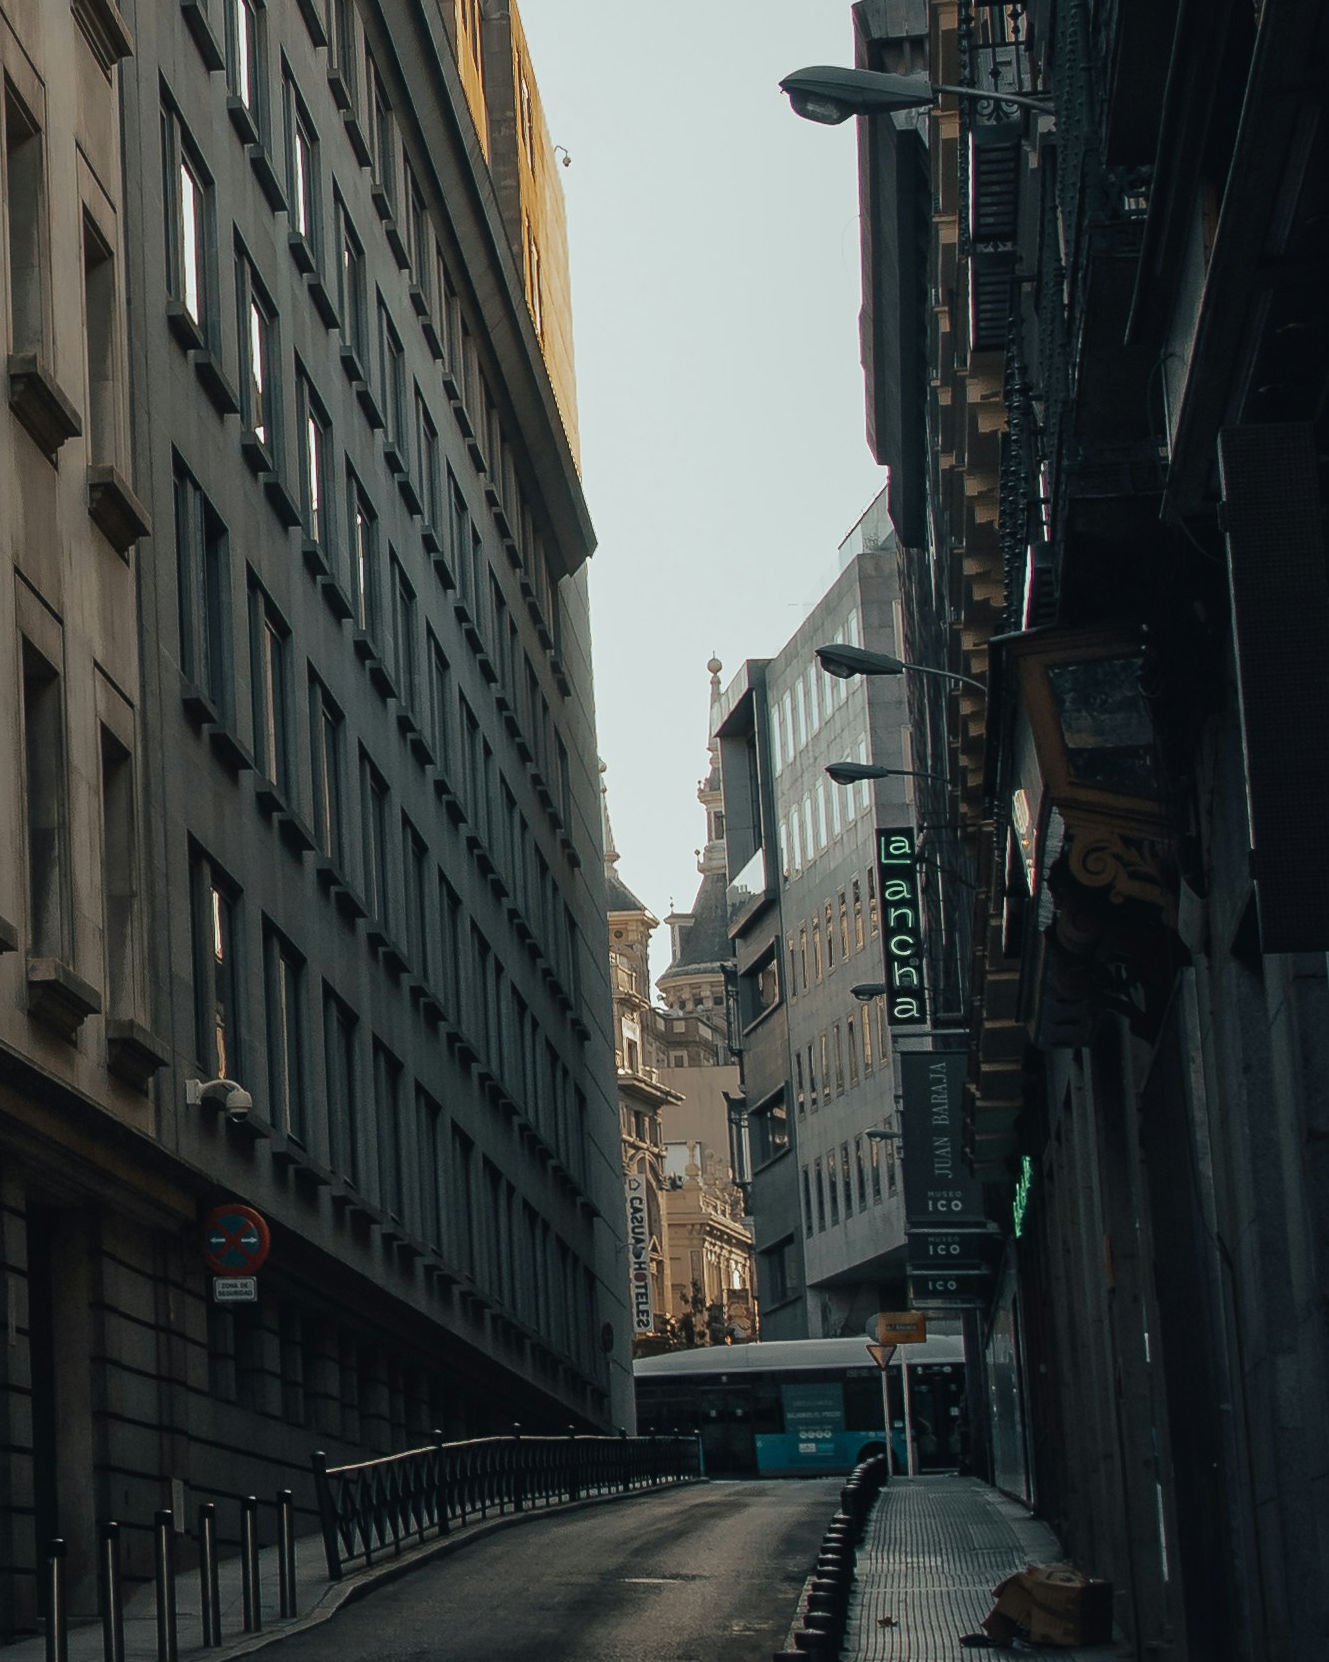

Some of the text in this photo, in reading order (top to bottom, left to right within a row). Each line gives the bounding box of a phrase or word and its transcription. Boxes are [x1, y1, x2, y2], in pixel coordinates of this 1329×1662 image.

[884, 879, 922, 1018] ancha
[929, 1061, 953, 1179] JUAN BARAJA
[927, 1190, 962, 1198] MUSEO
[928, 1199, 963, 1212] ICO
[929, 1244, 961, 1256] ICO
[629, 1196, 651, 1328] CASUA HOTELES
[928, 1280, 958, 1291] ICO
